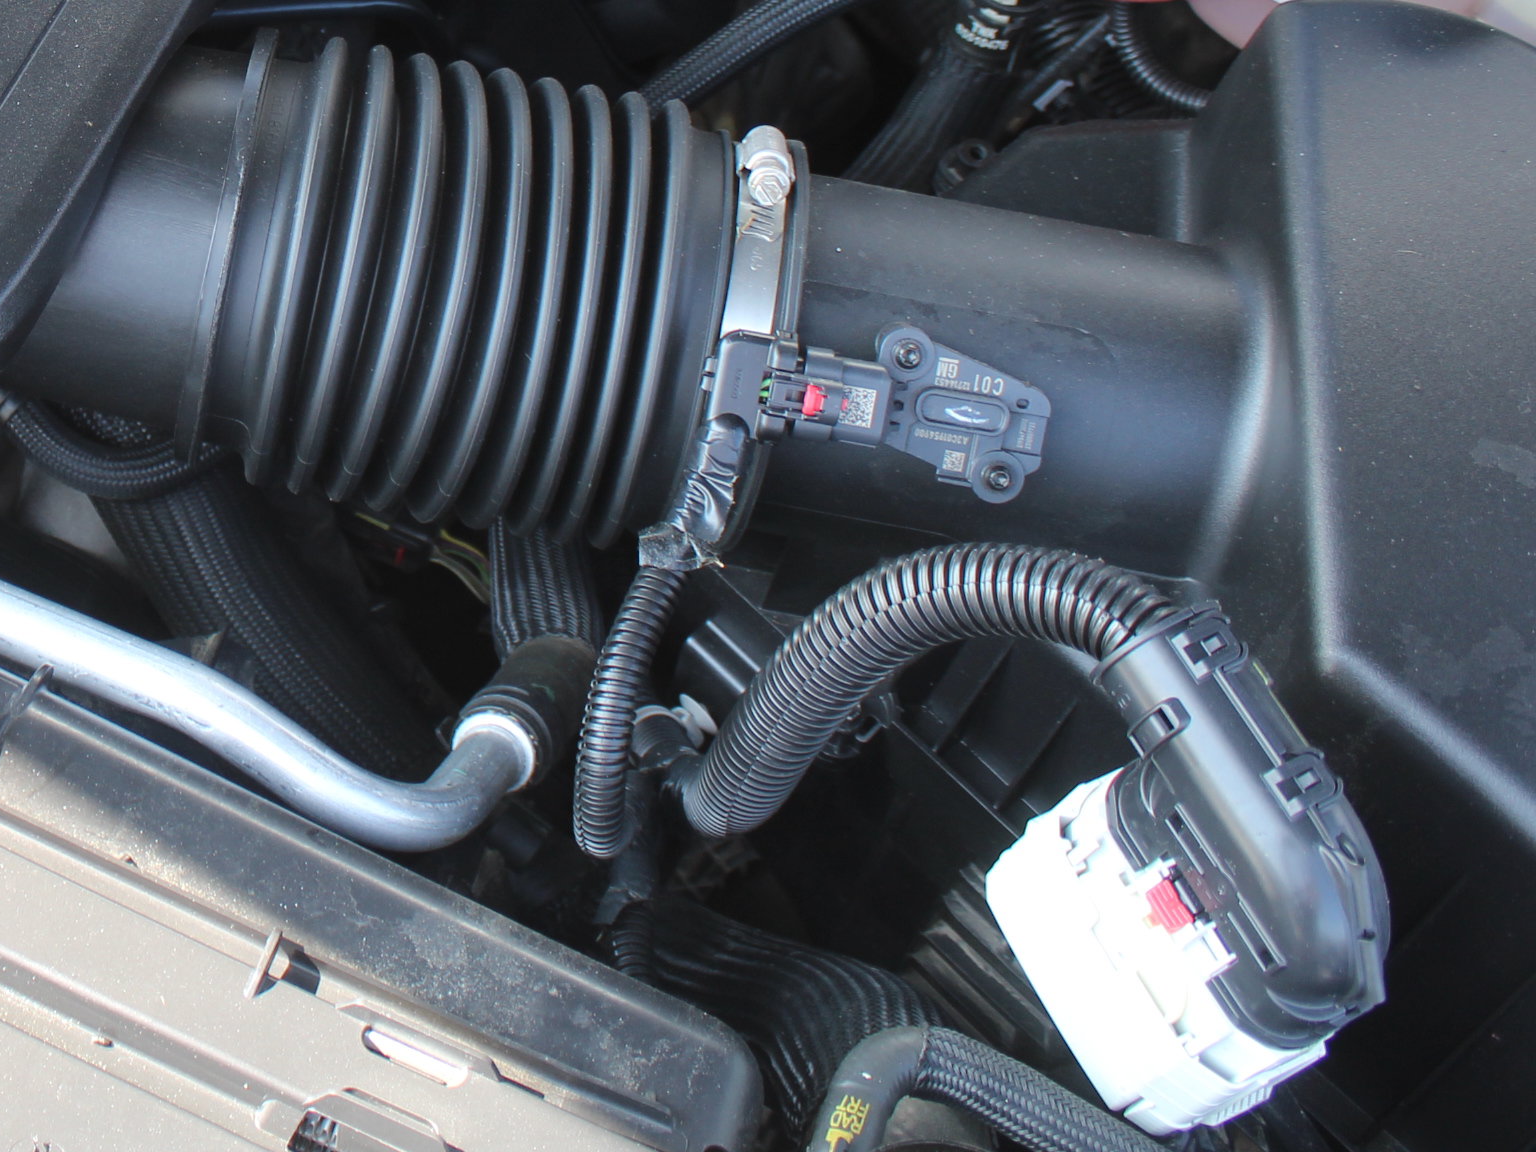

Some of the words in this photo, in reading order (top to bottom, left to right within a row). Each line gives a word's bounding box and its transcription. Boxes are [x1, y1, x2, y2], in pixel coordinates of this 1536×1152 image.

[936, 359, 959, 379] GM
[973, 374, 1004, 396] C01
[836, 1094, 870, 1119] FRT
[830, 1110, 864, 1135] RAD
